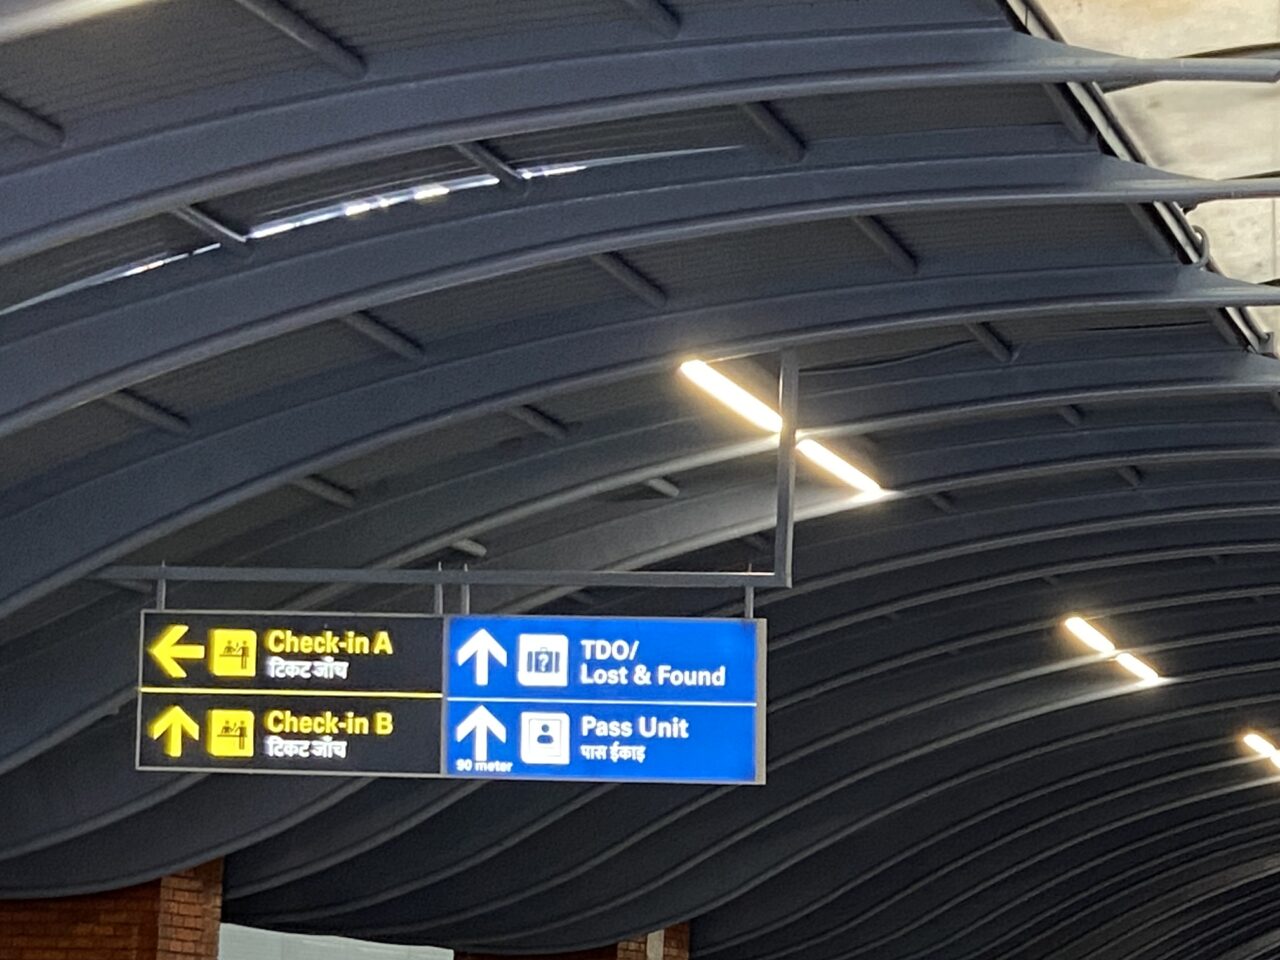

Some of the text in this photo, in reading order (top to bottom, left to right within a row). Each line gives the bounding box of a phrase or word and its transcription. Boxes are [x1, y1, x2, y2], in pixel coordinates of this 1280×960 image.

[265, 629, 393, 655] Check-in A
[580, 639, 640, 661] TDO/
[580, 662, 726, 687] Lost & Found
[264, 709, 394, 735] Check-in B
[581, 715, 690, 738] Pass Unit
[475, 760, 514, 773] meter
